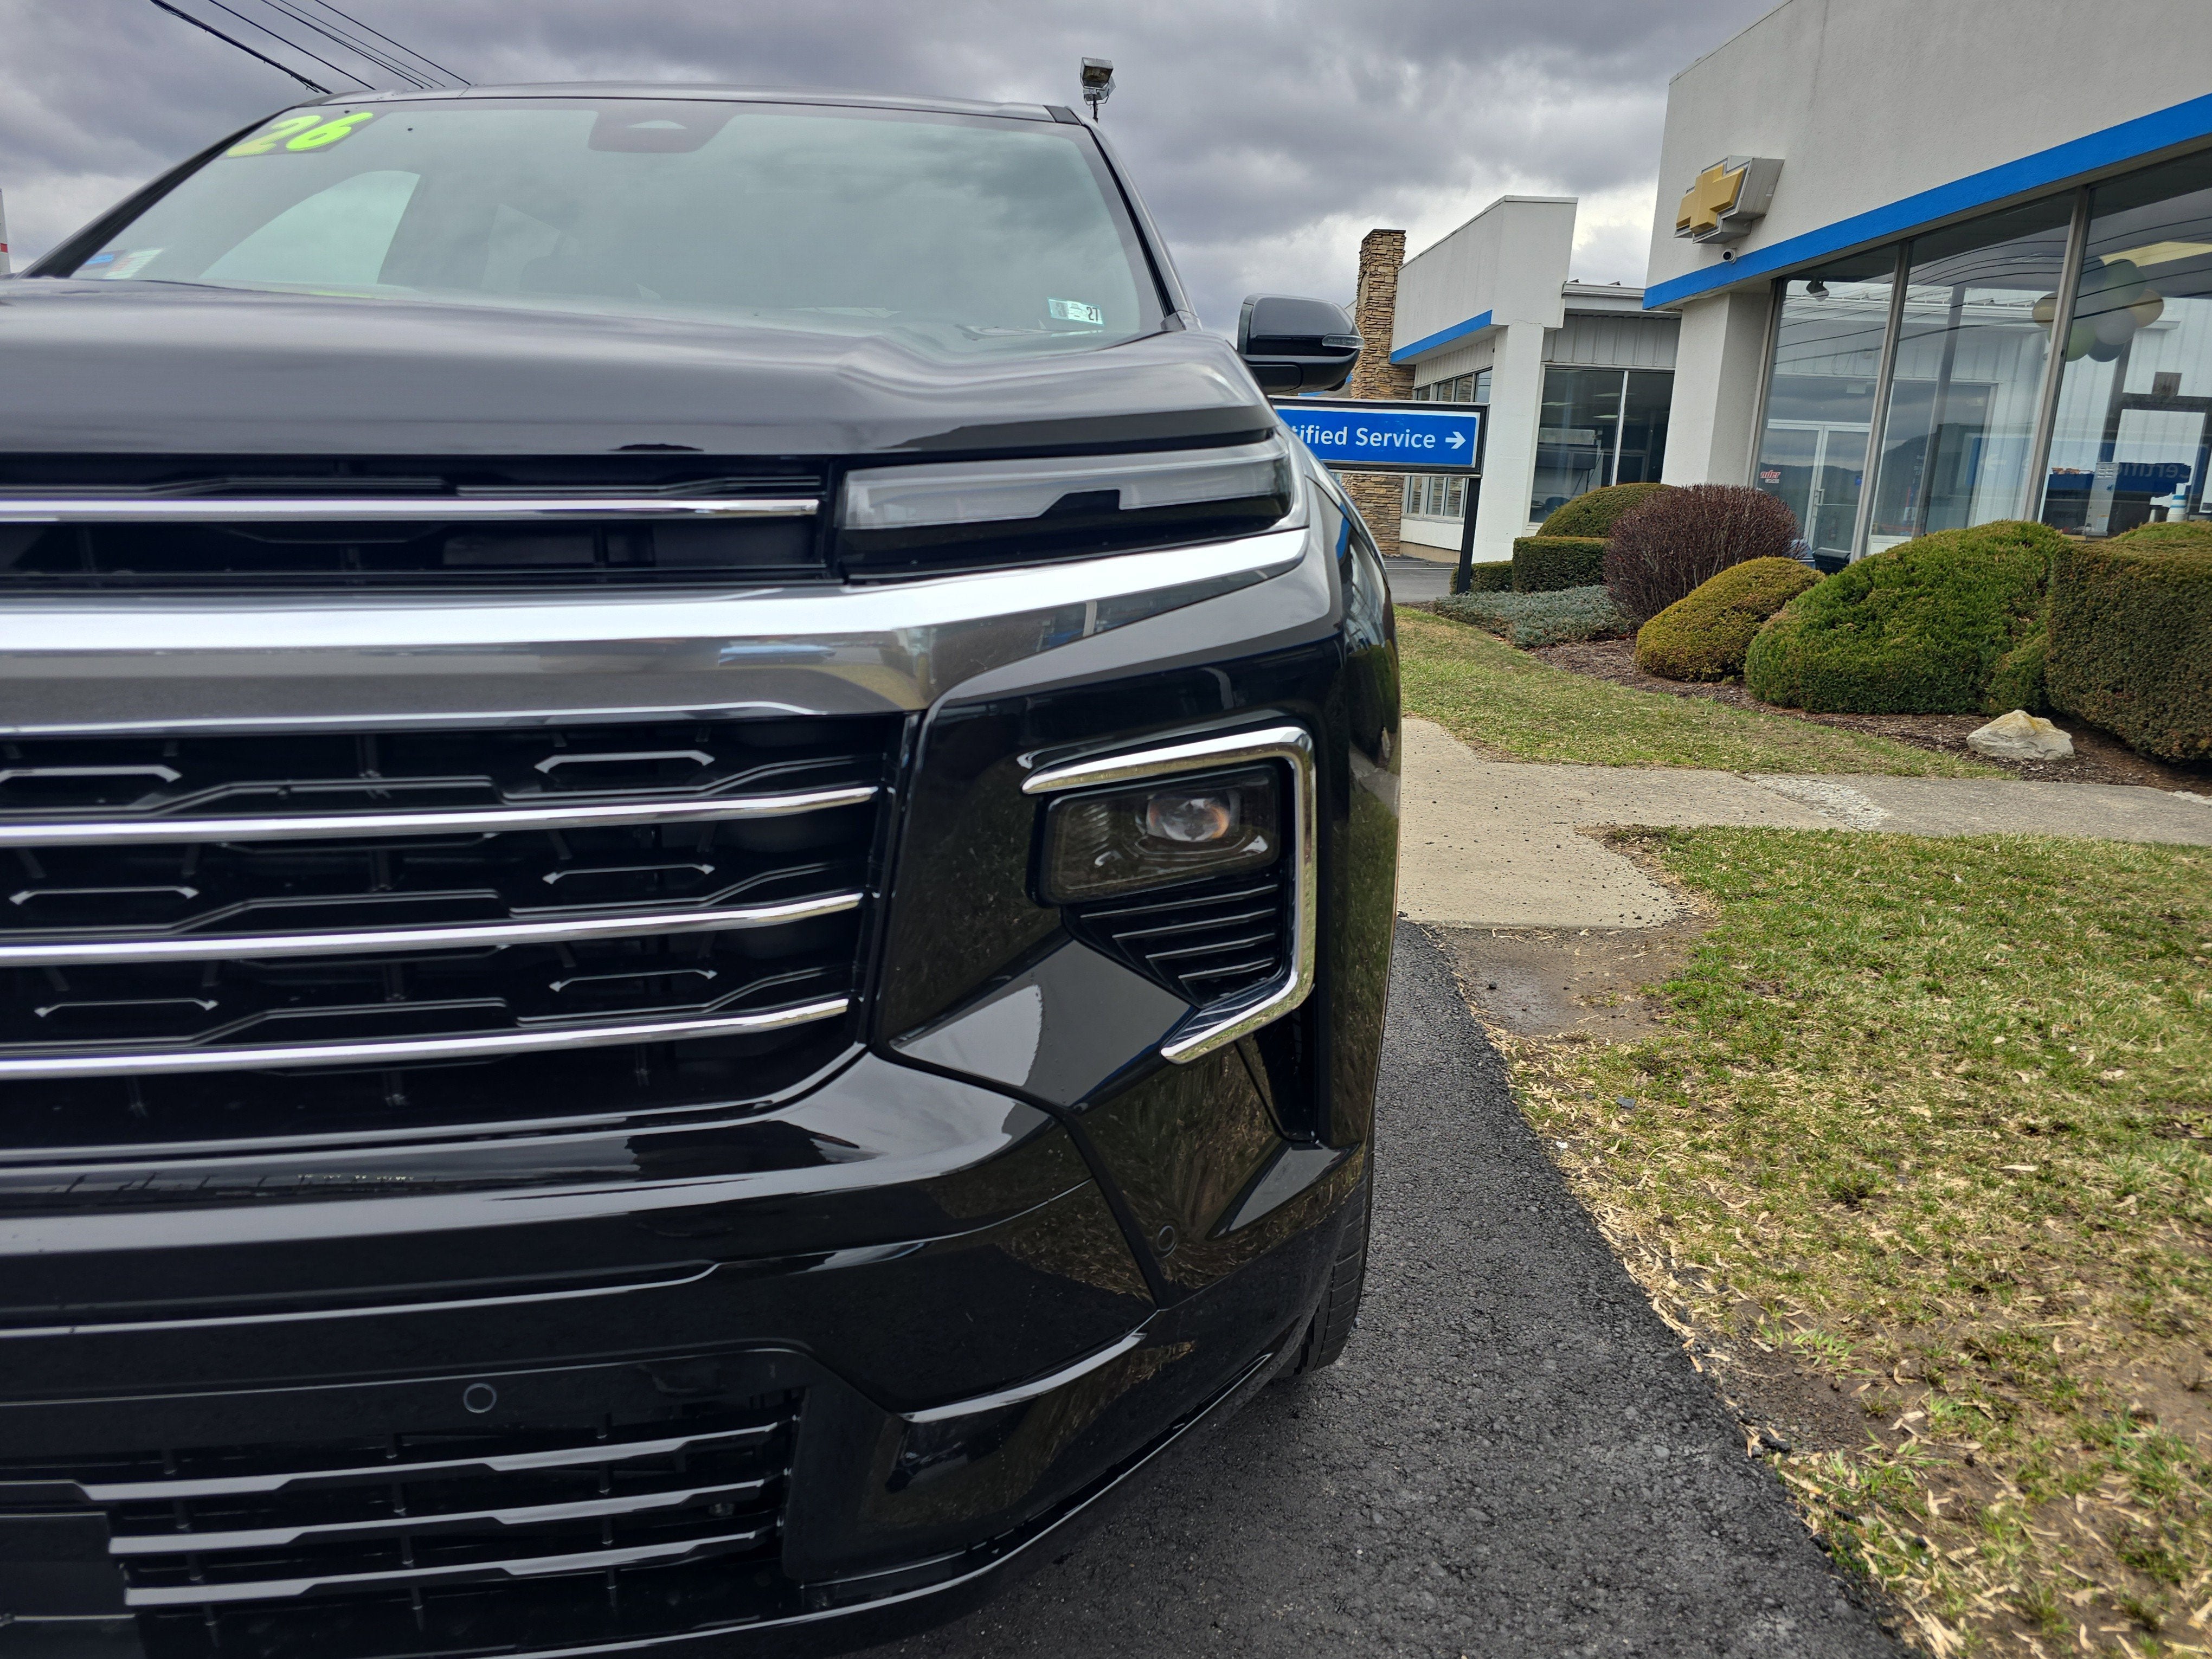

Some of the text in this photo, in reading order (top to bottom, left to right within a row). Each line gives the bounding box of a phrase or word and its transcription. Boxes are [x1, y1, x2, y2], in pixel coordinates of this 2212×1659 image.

[227, 112, 374, 157] 26
[1086, 306, 1098, 322] 27
[1355, 427, 1436, 449] Service
